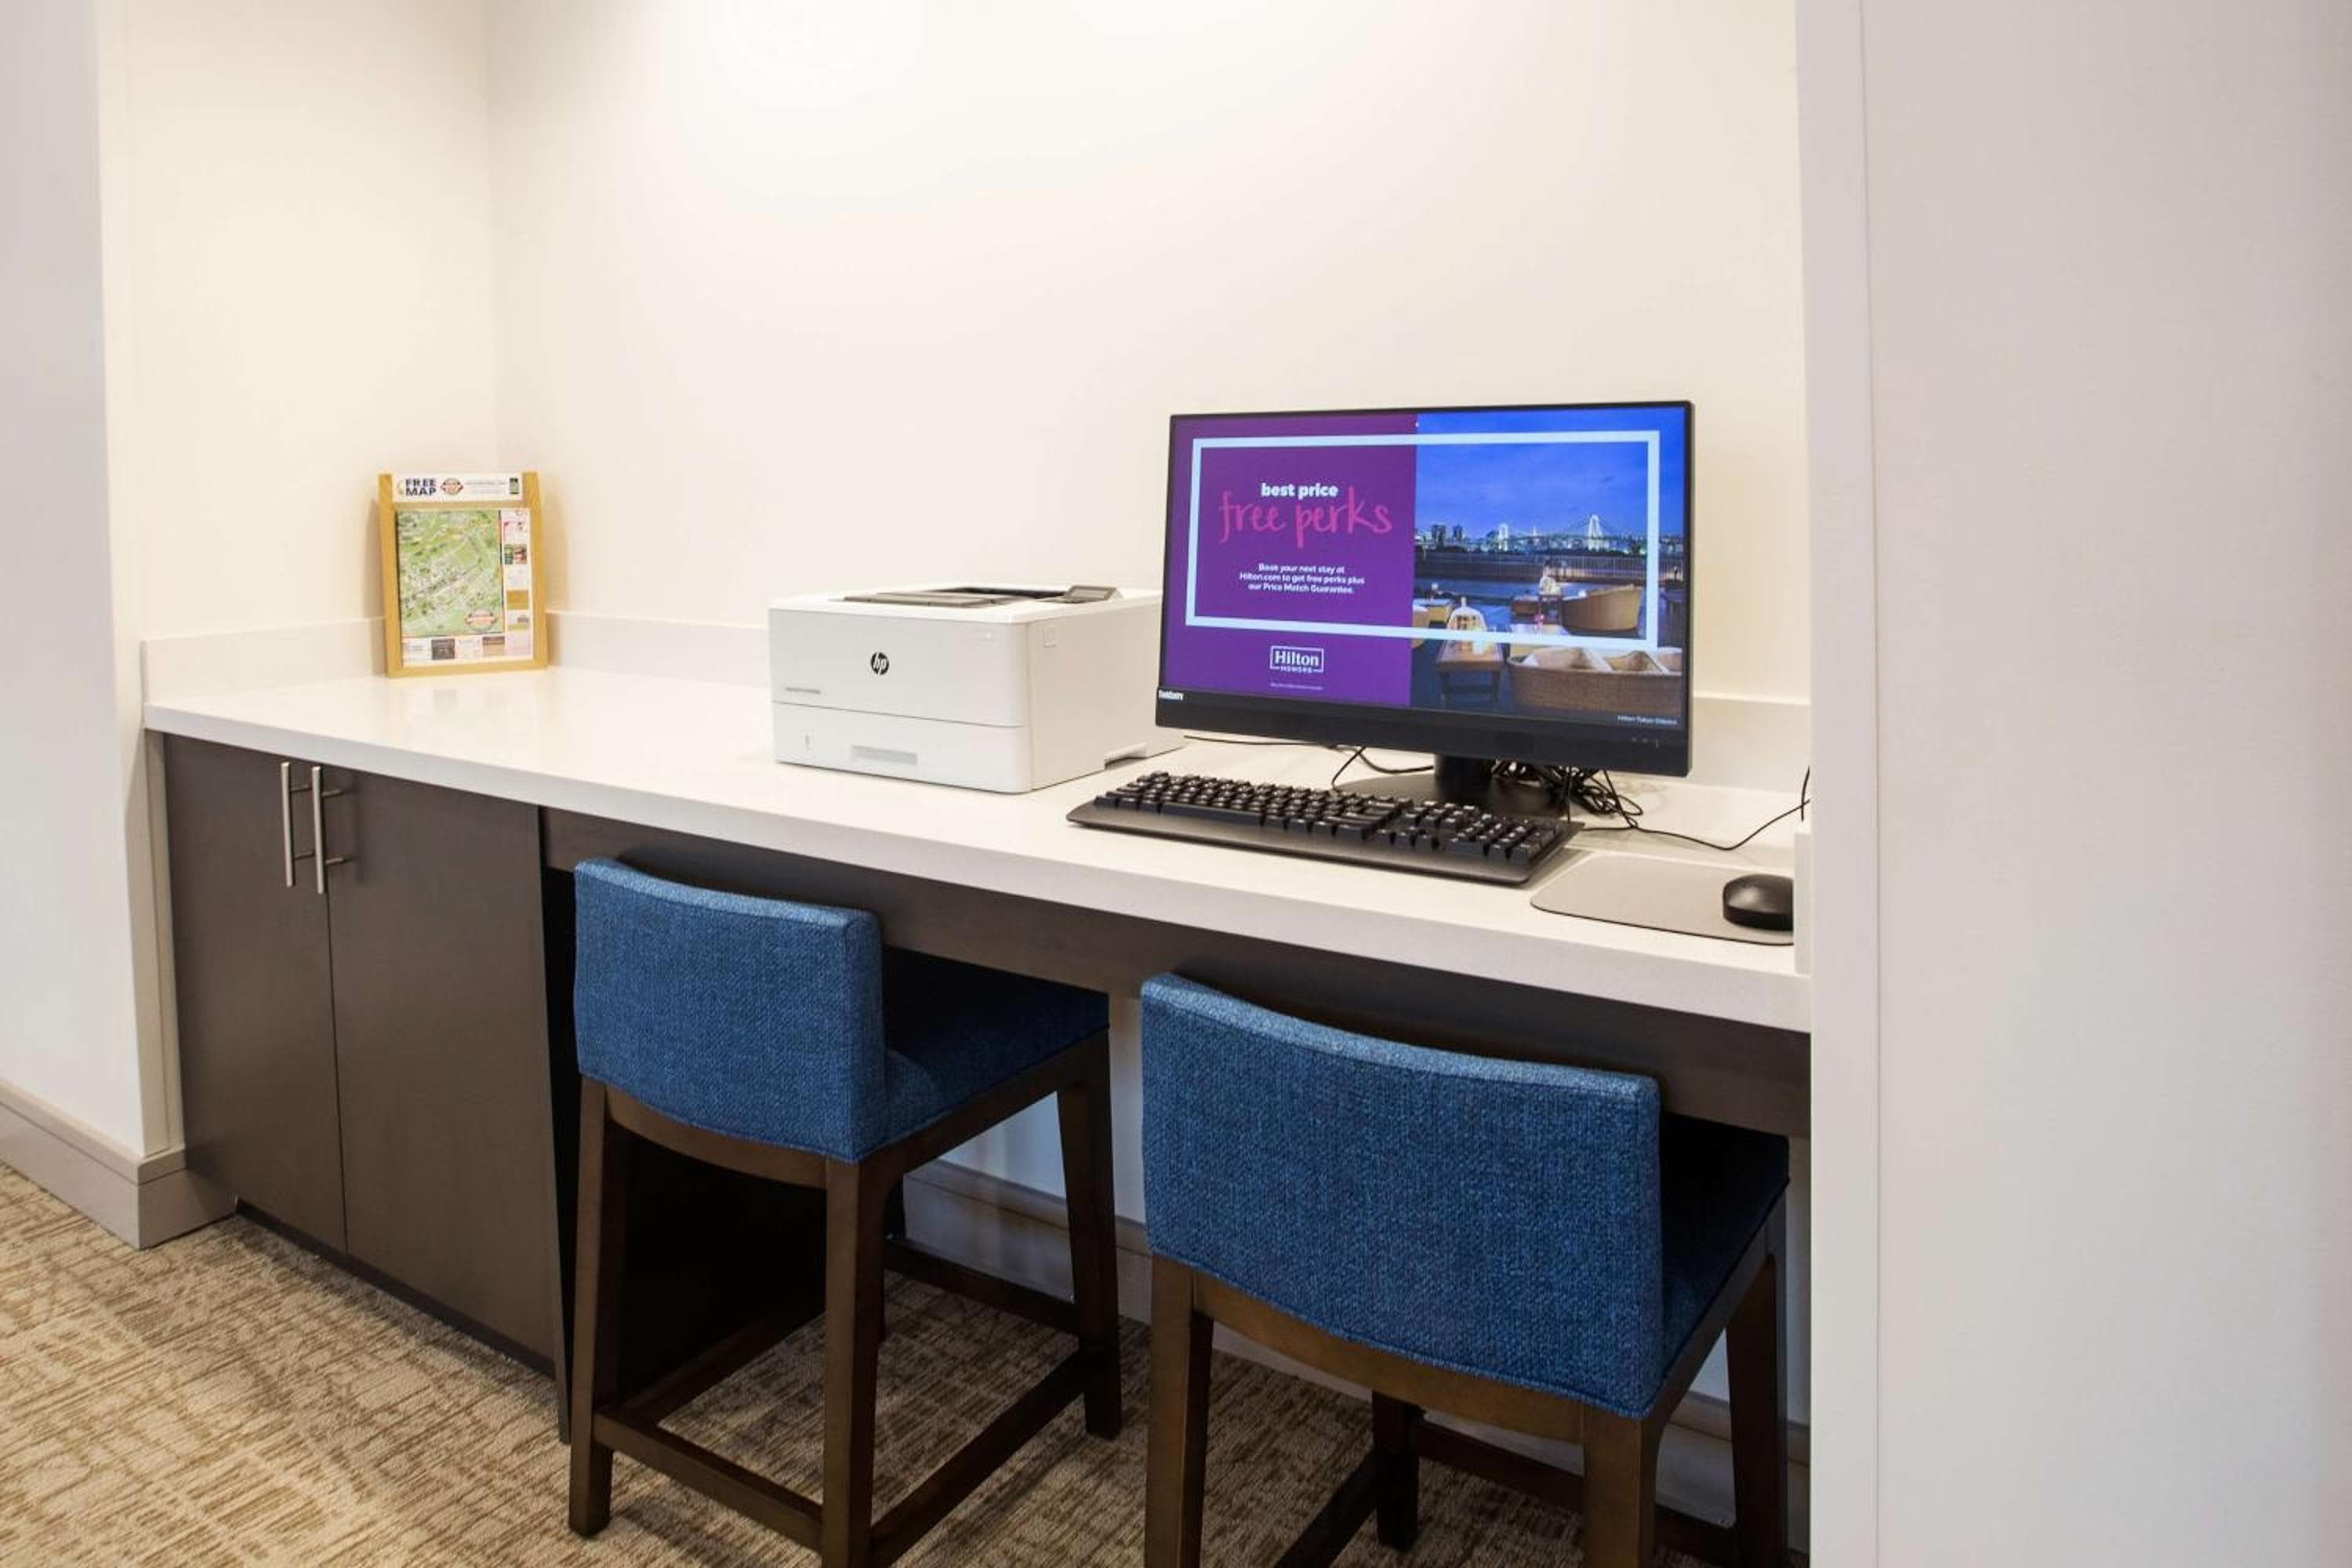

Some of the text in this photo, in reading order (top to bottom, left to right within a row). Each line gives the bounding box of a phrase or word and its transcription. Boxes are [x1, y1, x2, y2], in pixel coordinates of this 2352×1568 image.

[405, 478, 436, 487] FREE
[405, 487, 437, 496] MAP
[1261, 482, 1338, 500] best price
[1219, 485, 1392, 549] free perks
[1258, 563, 1278, 572] Book
[1280, 564, 1298, 573] your
[1298, 564, 1316, 573] next
[1319, 565, 1334, 575] stay
[1240, 572, 1365, 585] Hilton.com to get free perks plus
[1264, 583, 1283, 591] Price
[1284, 583, 1310, 592] Match
[872, 652, 888, 675] hp
[1275, 651, 1319, 666] Hilton
